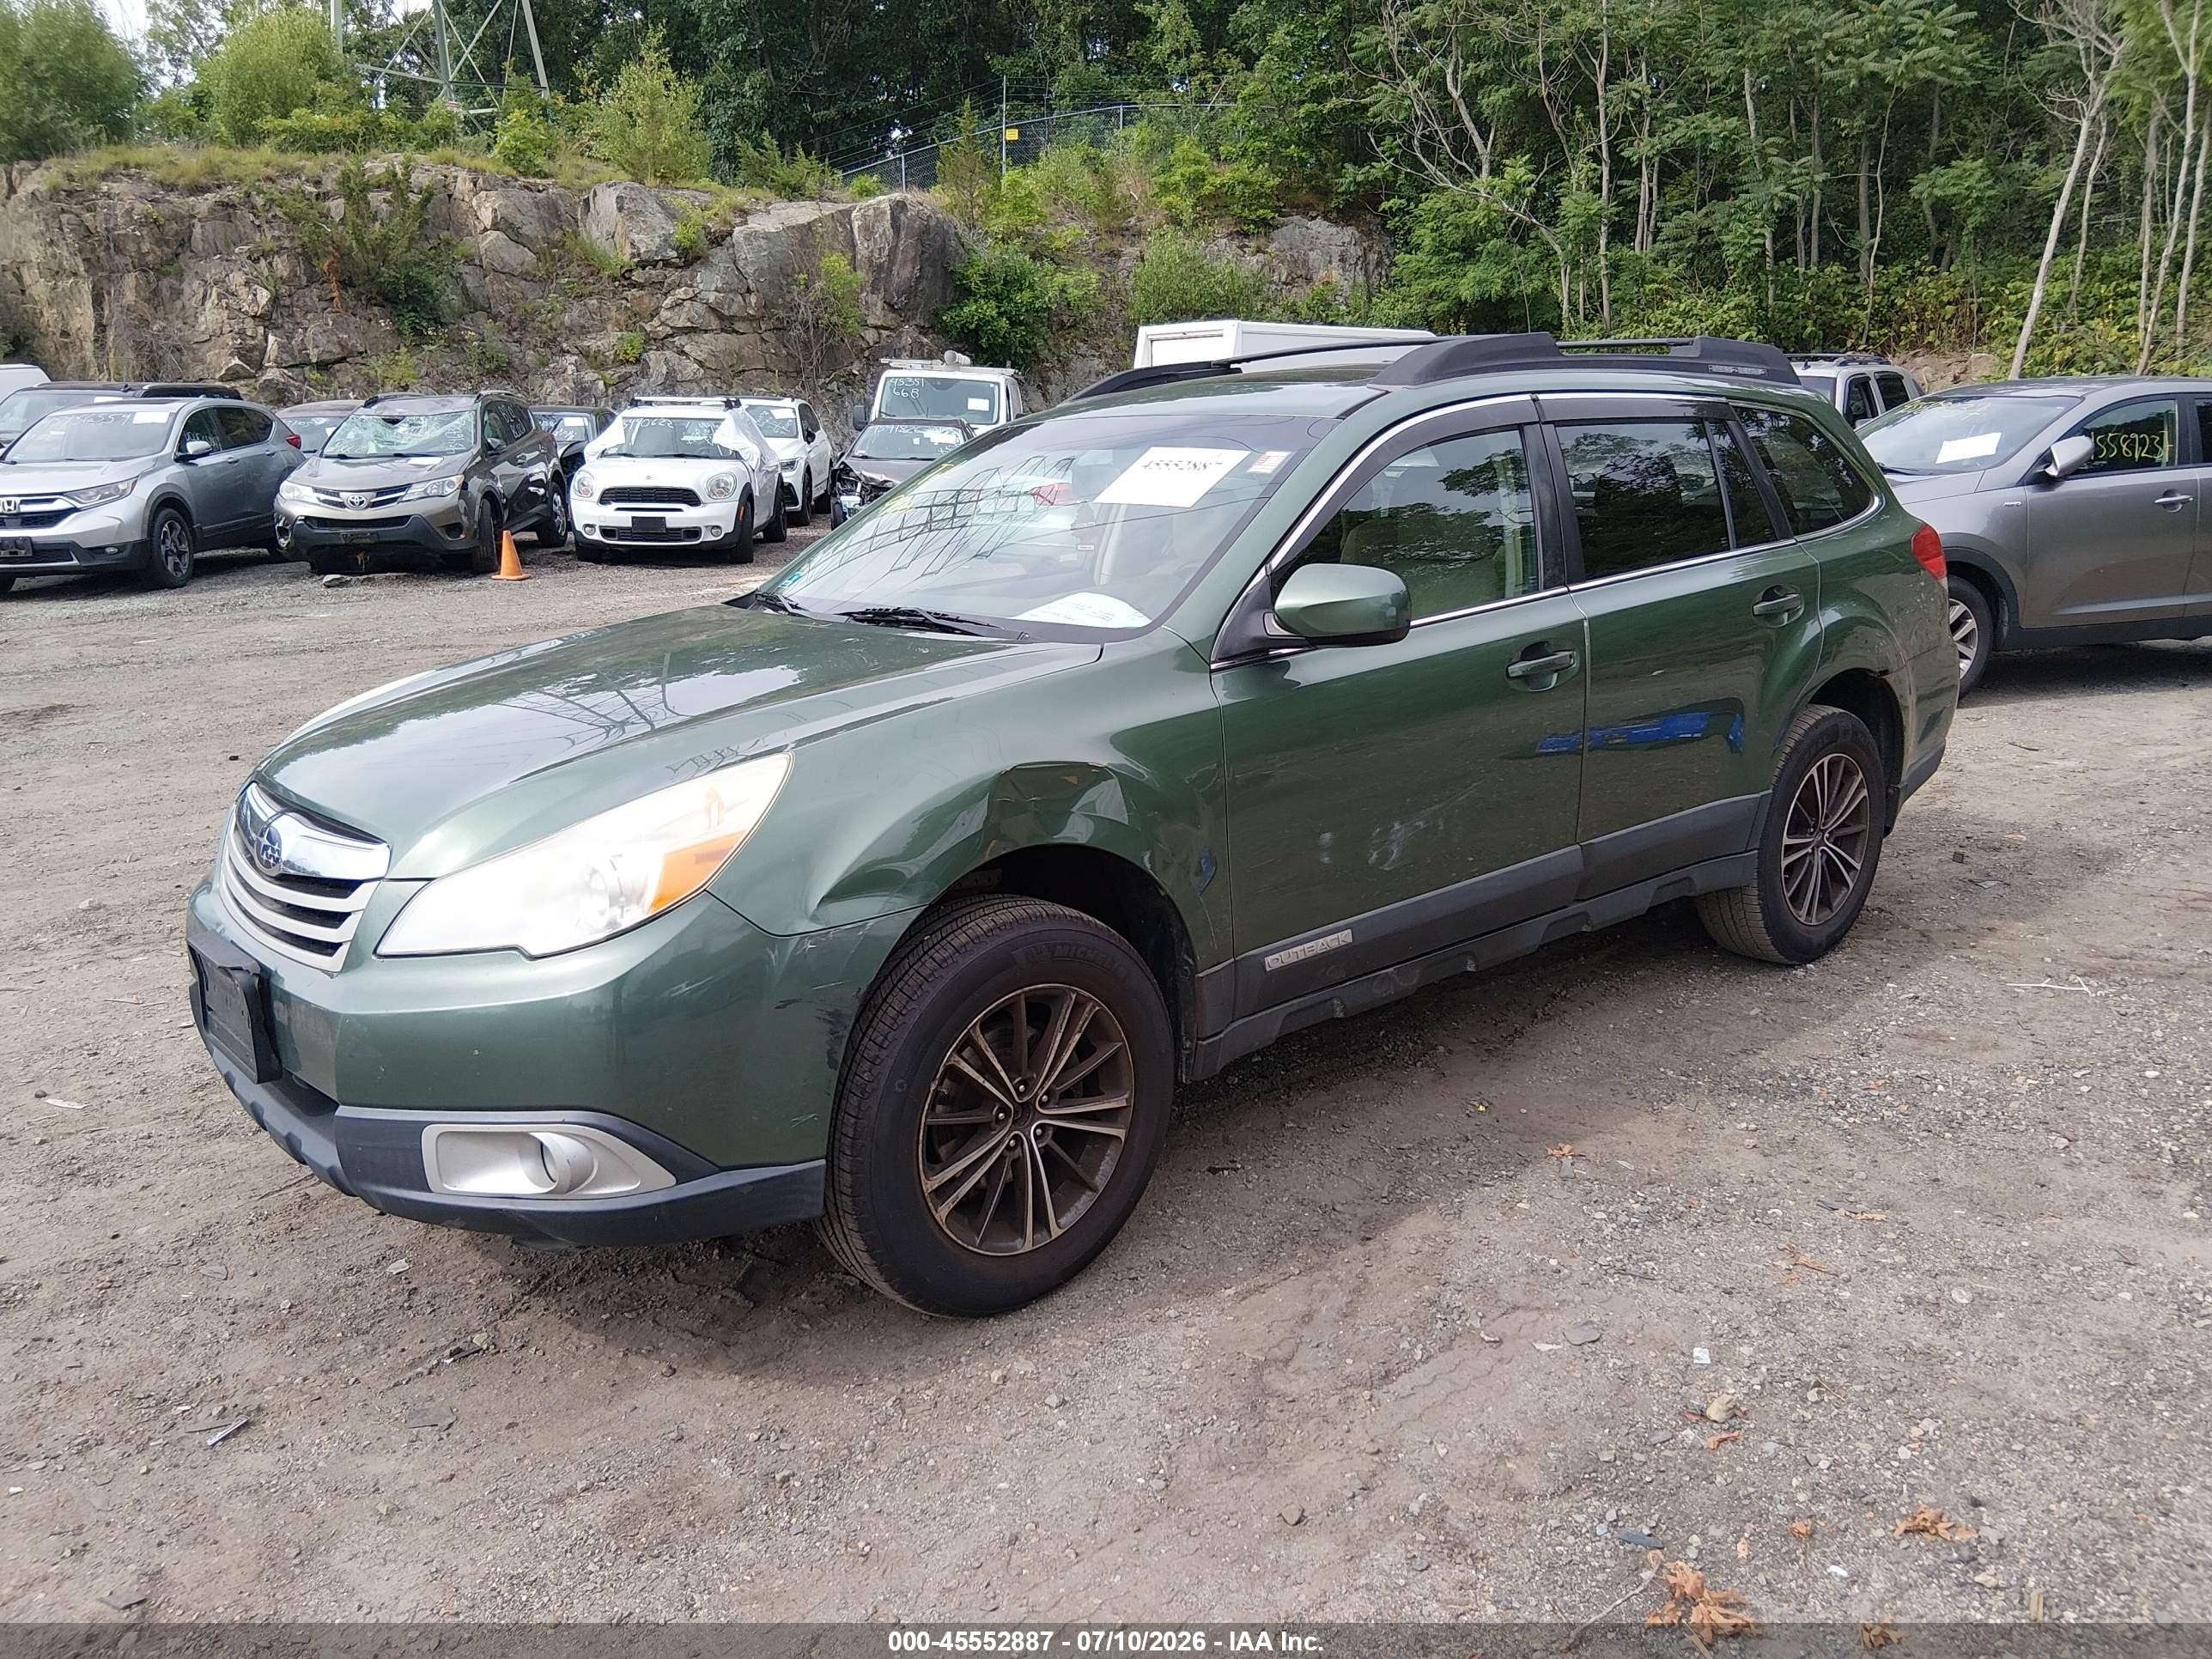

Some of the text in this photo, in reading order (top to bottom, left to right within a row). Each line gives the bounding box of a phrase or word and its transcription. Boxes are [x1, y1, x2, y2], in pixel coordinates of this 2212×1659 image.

[890, 377, 925, 389] 45351
[893, 388, 920, 399] 668
[1266, 930, 1352, 970] OUTBACK
